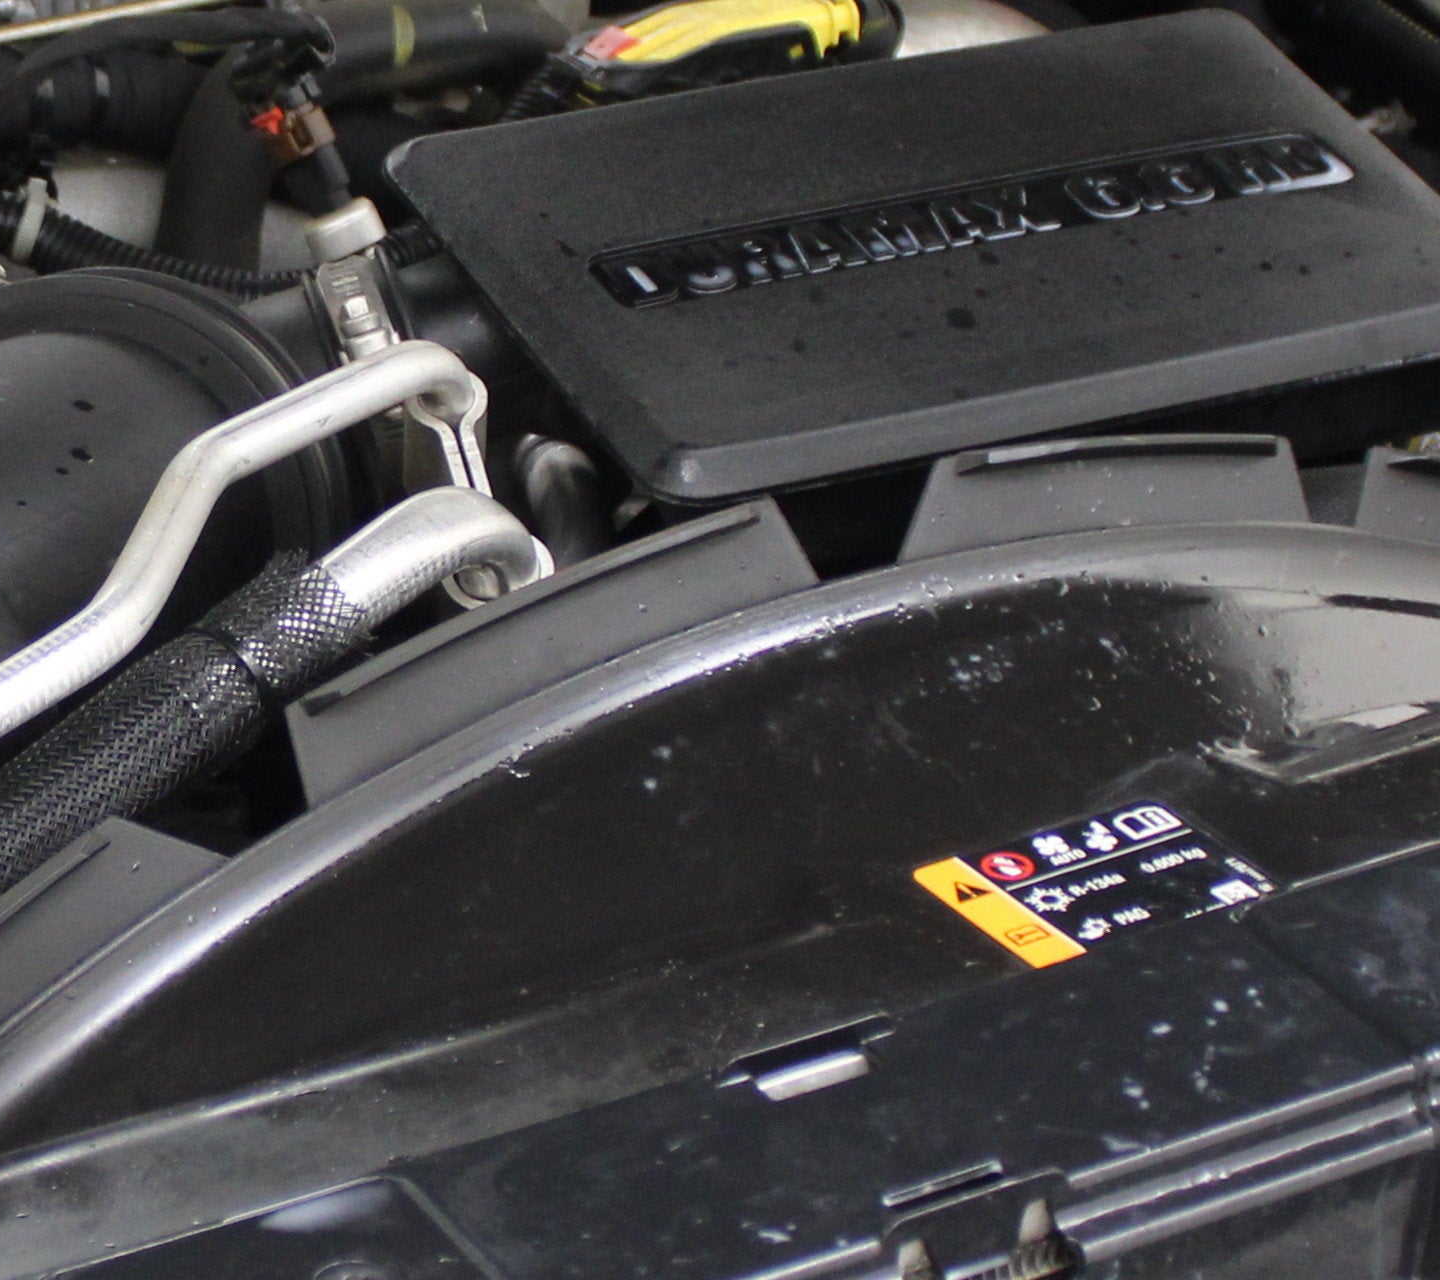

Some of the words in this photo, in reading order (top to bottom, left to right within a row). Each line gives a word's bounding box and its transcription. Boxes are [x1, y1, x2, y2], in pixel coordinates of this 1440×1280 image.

[597, 182, 1061, 308] DURAMAX
[1064, 158, 1215, 220] 6.6
[1050, 847, 1088, 867] AUTO
[1181, 846, 1208, 863] kg
[1068, 873, 1127, 898] R-134a
[1113, 906, 1152, 926] PAG
